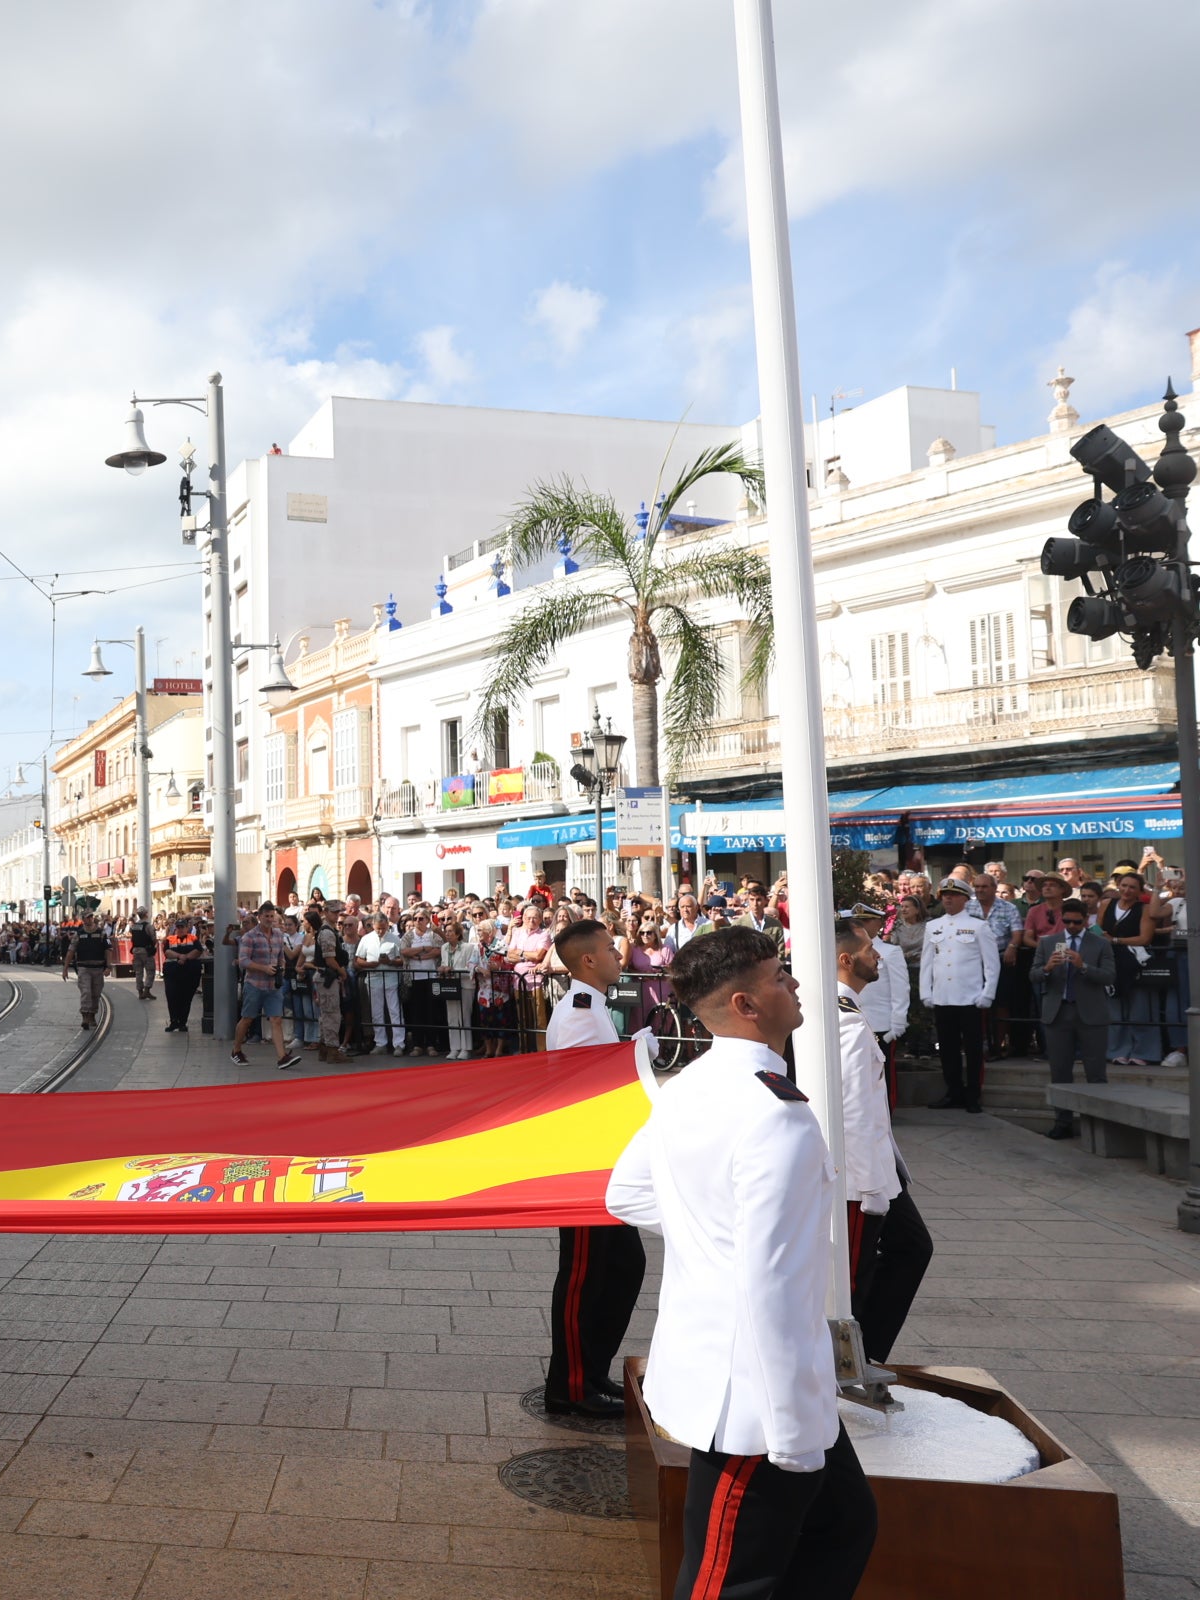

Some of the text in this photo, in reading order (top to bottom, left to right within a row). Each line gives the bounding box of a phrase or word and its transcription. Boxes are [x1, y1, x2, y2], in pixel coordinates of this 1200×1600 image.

[165, 682, 196, 690] HOTEL
[97, 751, 105, 784] HOTEL
[552, 825, 597, 841] TAPAS
[955, 817, 1135, 839] DESAYUNOS Y MENÚS
[724, 836, 765, 848] TAPAS
[766, 836, 777, 848] Y
